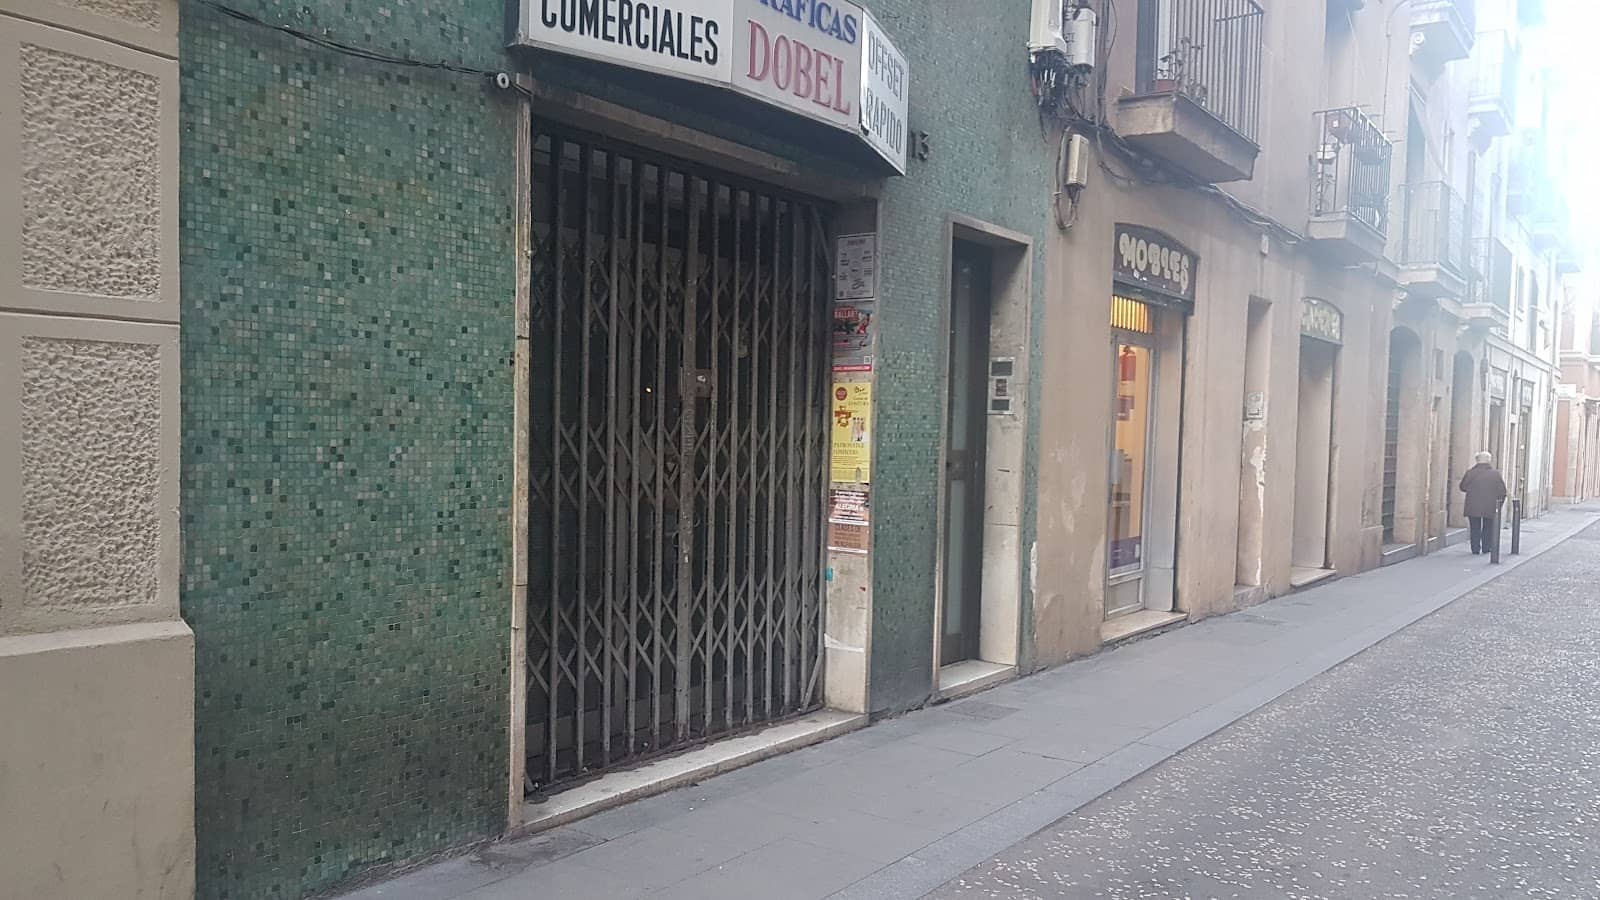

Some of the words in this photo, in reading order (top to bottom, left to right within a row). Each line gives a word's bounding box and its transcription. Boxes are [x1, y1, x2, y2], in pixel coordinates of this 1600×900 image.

[541, 0, 719, 66] COMERCIALES
[868, 30, 904, 102] OFFSET
[747, 20, 851, 116] DOBEL
[865, 88, 902, 155] RAPIDO
[1119, 232, 1189, 295] MOBLES
